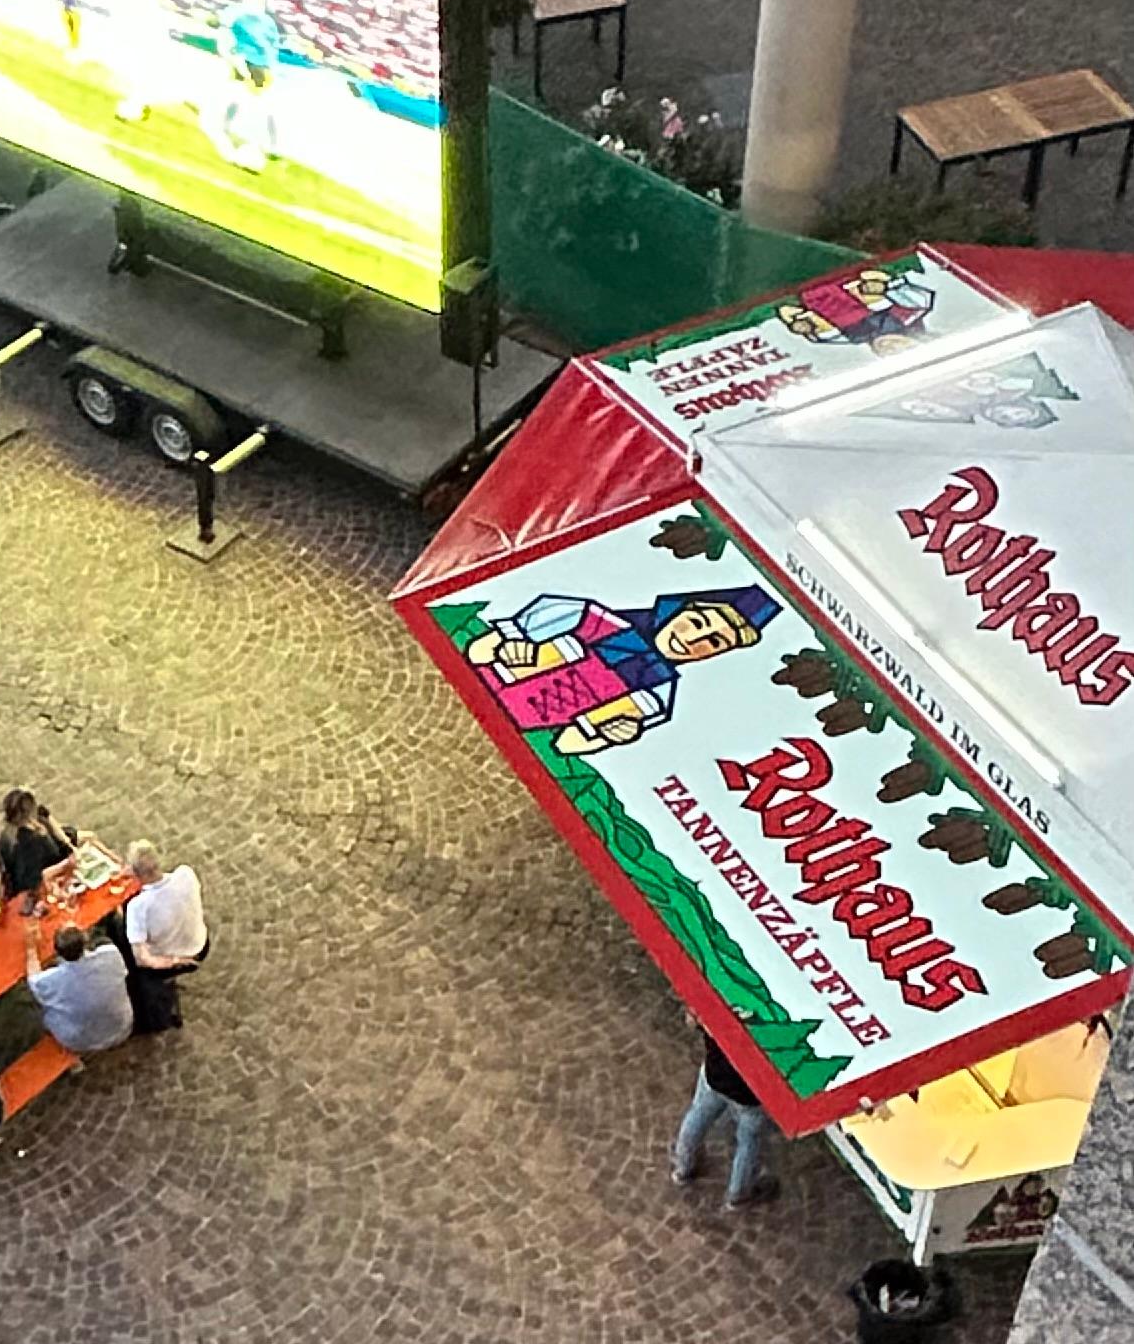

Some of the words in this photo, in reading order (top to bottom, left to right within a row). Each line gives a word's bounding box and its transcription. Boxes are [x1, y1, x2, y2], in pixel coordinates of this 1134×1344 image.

[659, 347, 792, 397] TANNEN
[784, 551, 945, 725] SCHWARZWALD
[949, 720, 981, 766] IM
[987, 761, 1052, 835] GLAS
[896, 466, 1134, 706] Rothaus
[651, 773, 892, 1049] TANNENZÄPFLE
[715, 736, 990, 1013] Rothaus
